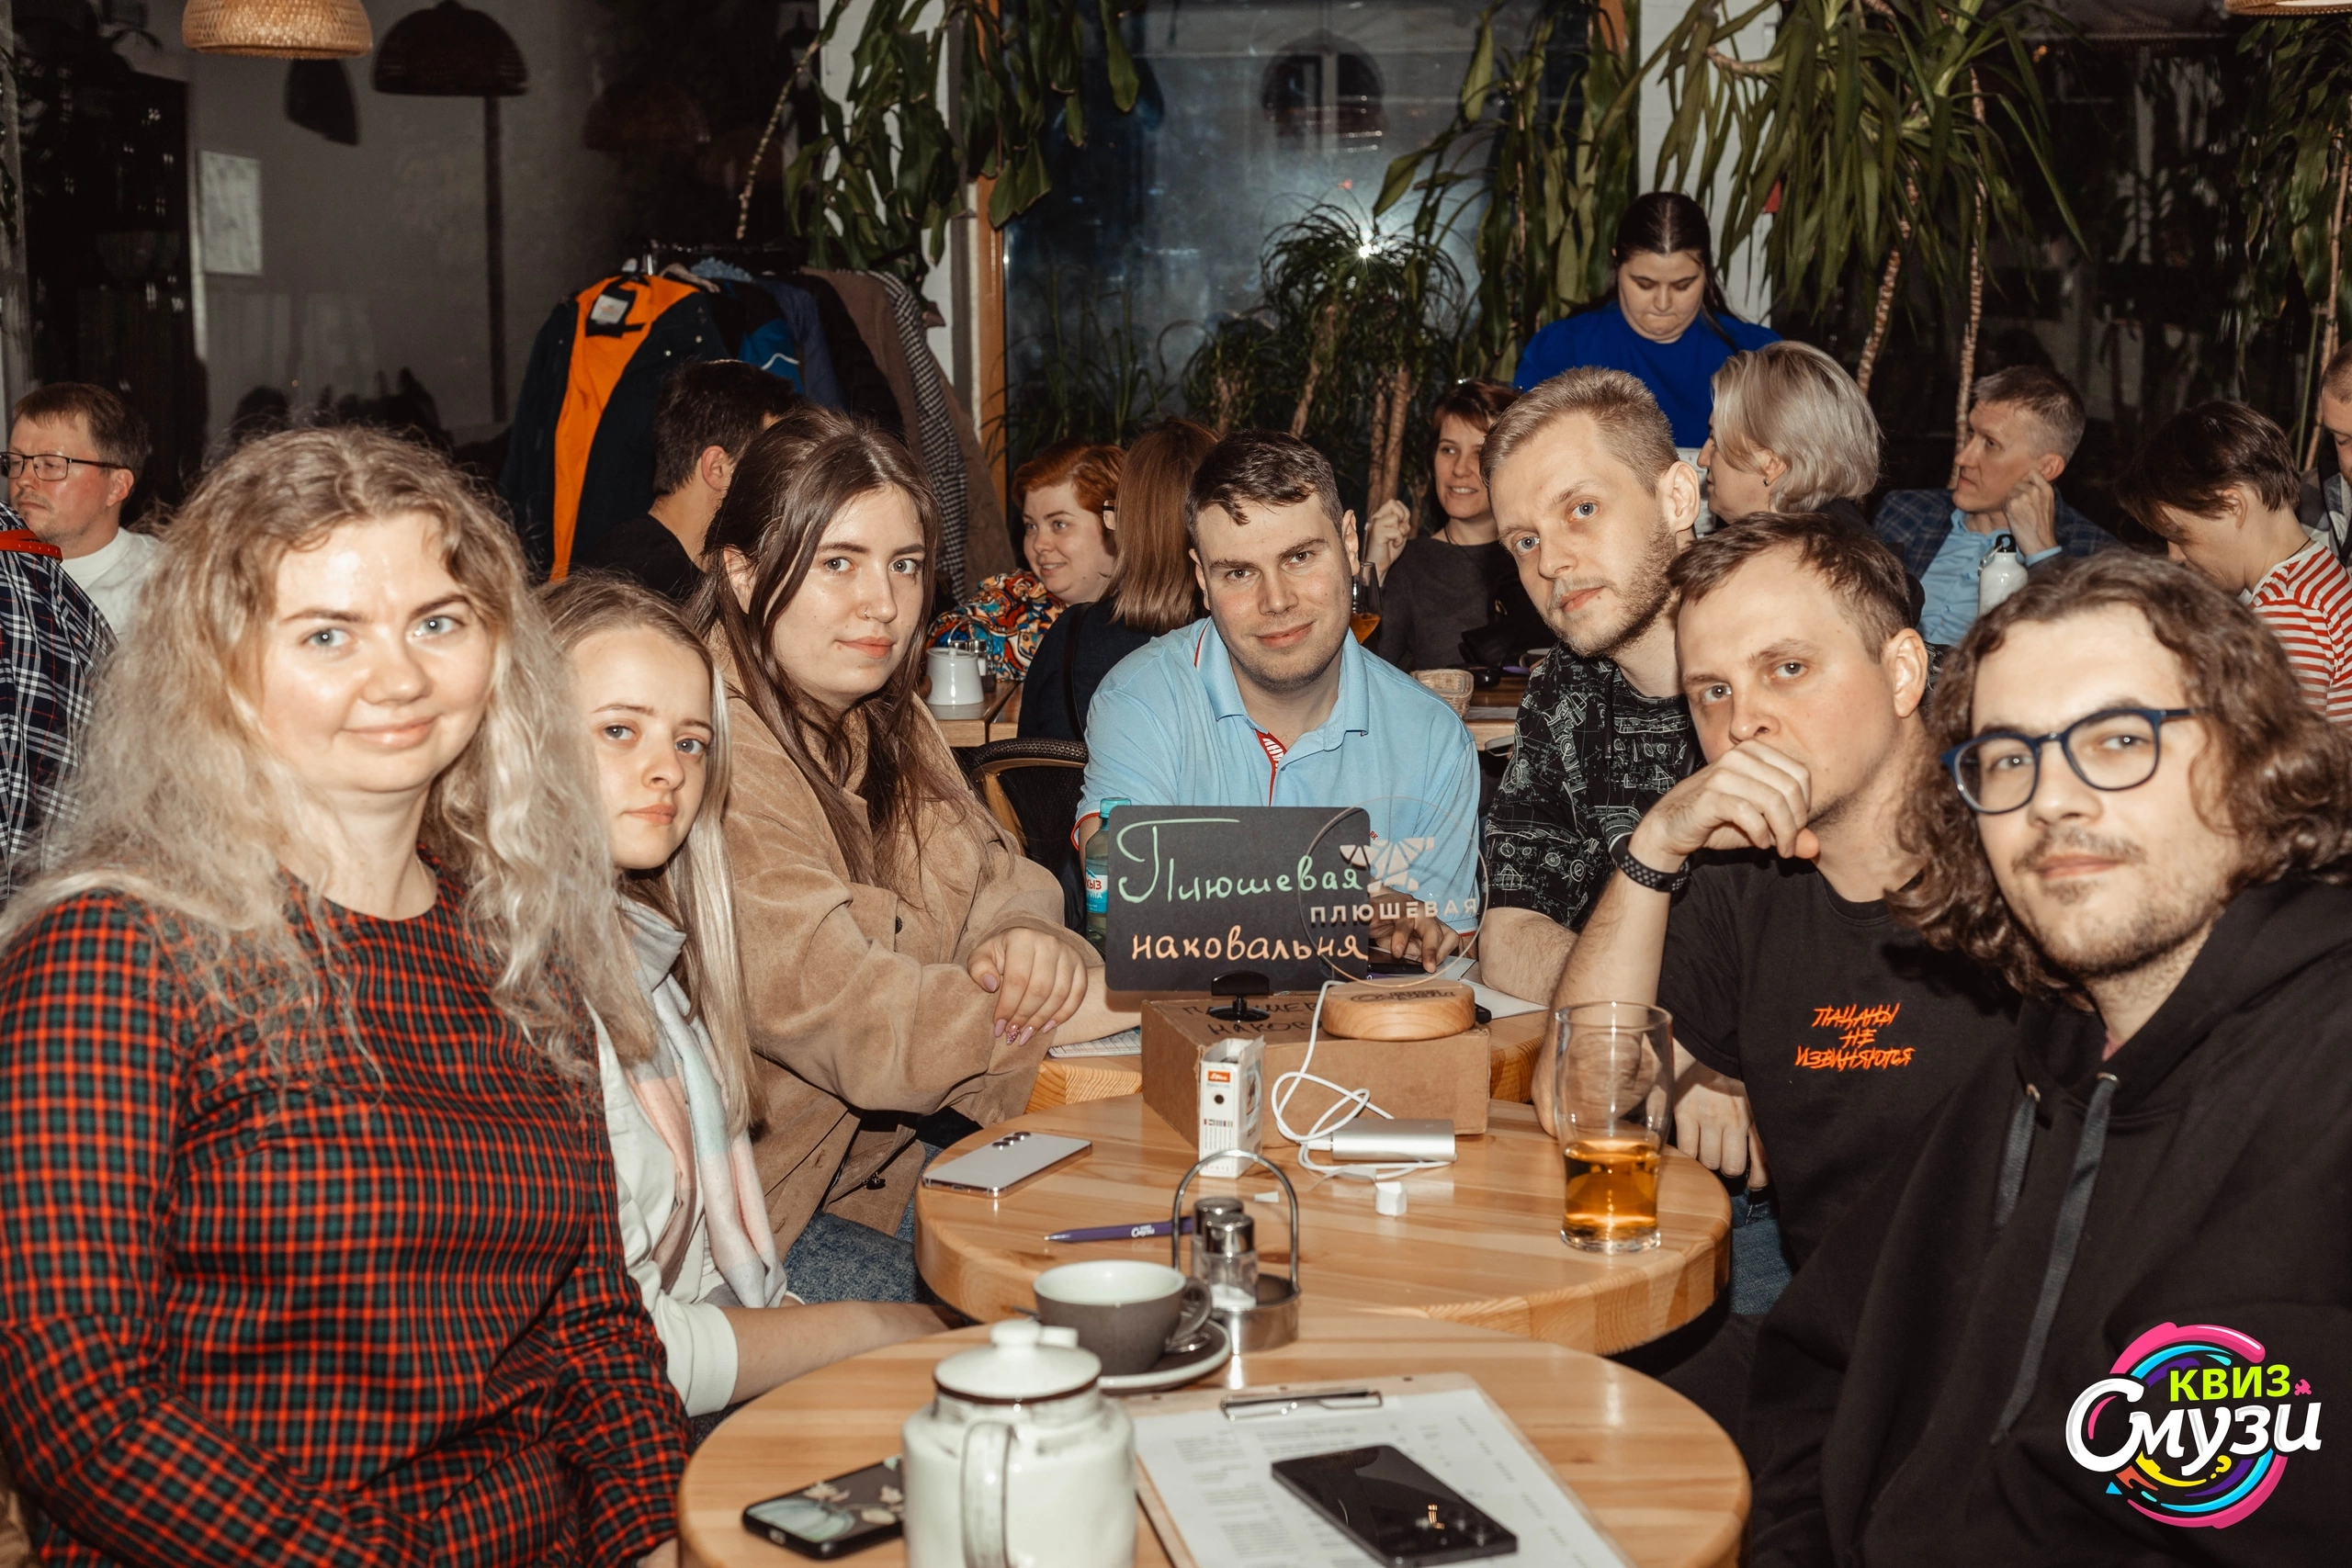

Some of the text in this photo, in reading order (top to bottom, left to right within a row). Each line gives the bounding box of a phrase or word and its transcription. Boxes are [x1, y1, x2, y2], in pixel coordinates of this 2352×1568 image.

[1116, 818, 1364, 904] Плюшевая
[1310, 898, 1478, 924] ПЛЮШЕВАЯ
[1131, 925, 1369, 961] наковальня
[1812, 1002, 1900, 1030] ПАЦАНЫ
[1838, 1028, 1877, 1049] НЕ
[1794, 1045, 1916, 1072] ИЗВИНЯЮТСЯ
